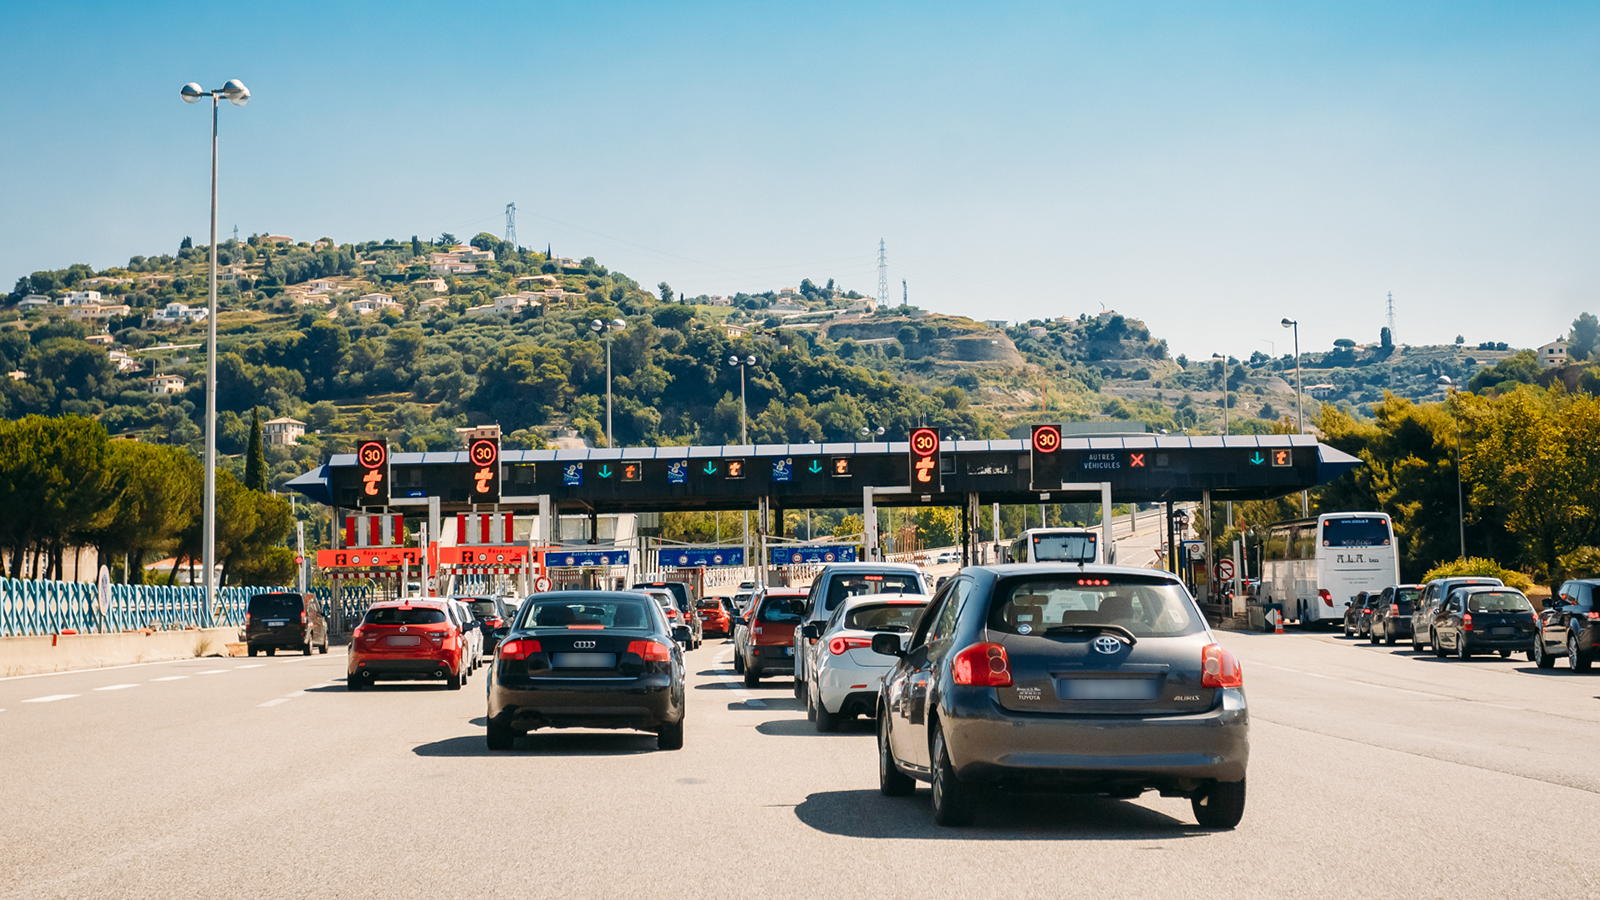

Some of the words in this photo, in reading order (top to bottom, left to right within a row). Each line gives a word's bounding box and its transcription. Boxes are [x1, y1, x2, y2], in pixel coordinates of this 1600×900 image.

[917, 436, 933, 449] 30
[1039, 433, 1055, 446] 30
[364, 449, 380, 462] 30
[476, 447, 492, 460] 30
[915, 456, 936, 483] t
[1083, 461, 1121, 469] VÉHICULES
[363, 469, 383, 496] t
[474, 467, 494, 494] t
